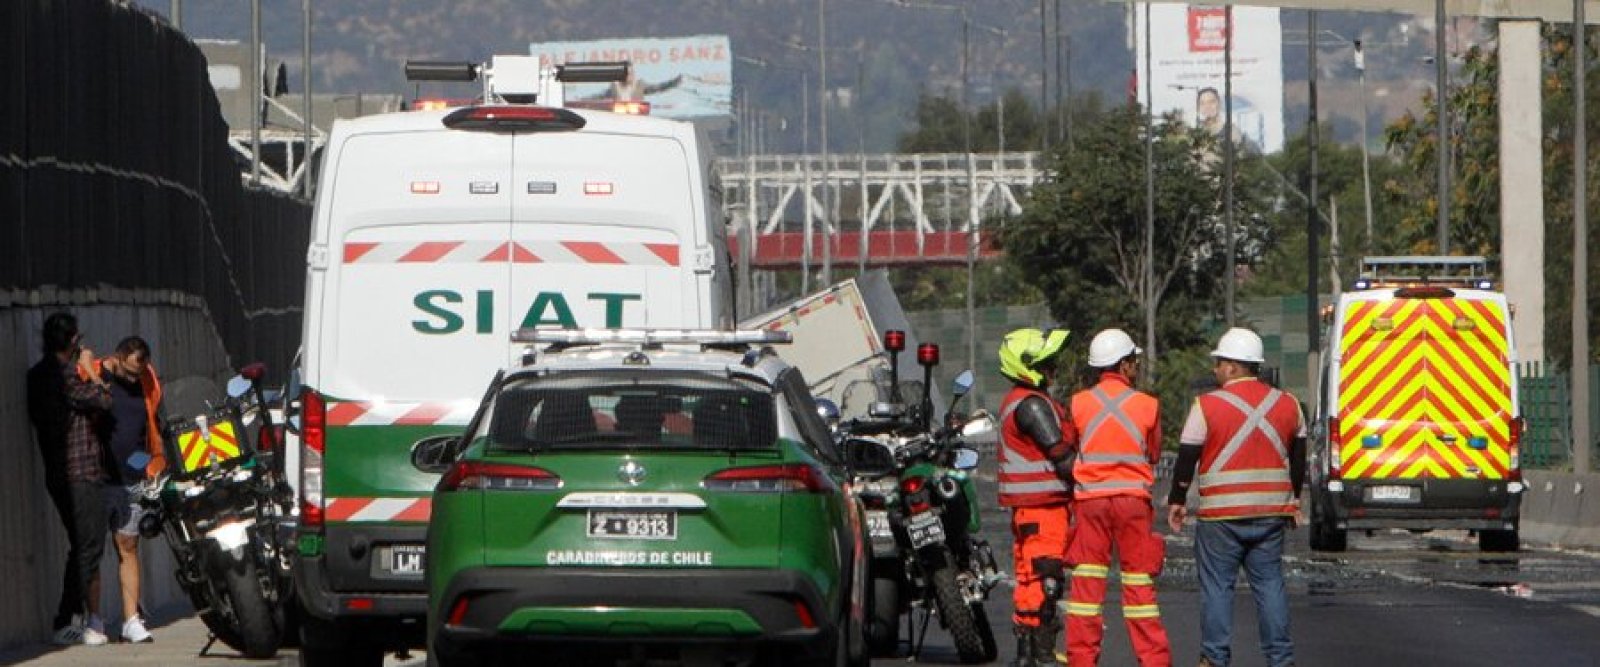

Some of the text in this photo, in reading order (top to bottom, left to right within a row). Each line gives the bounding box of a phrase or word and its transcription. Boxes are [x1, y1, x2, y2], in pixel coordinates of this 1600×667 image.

[669, 43, 726, 62] SANZ
[411, 289, 642, 335] SIAT
[626, 518, 669, 537] 9313
[546, 550, 712, 565] CARABINEROS DE CHILE
